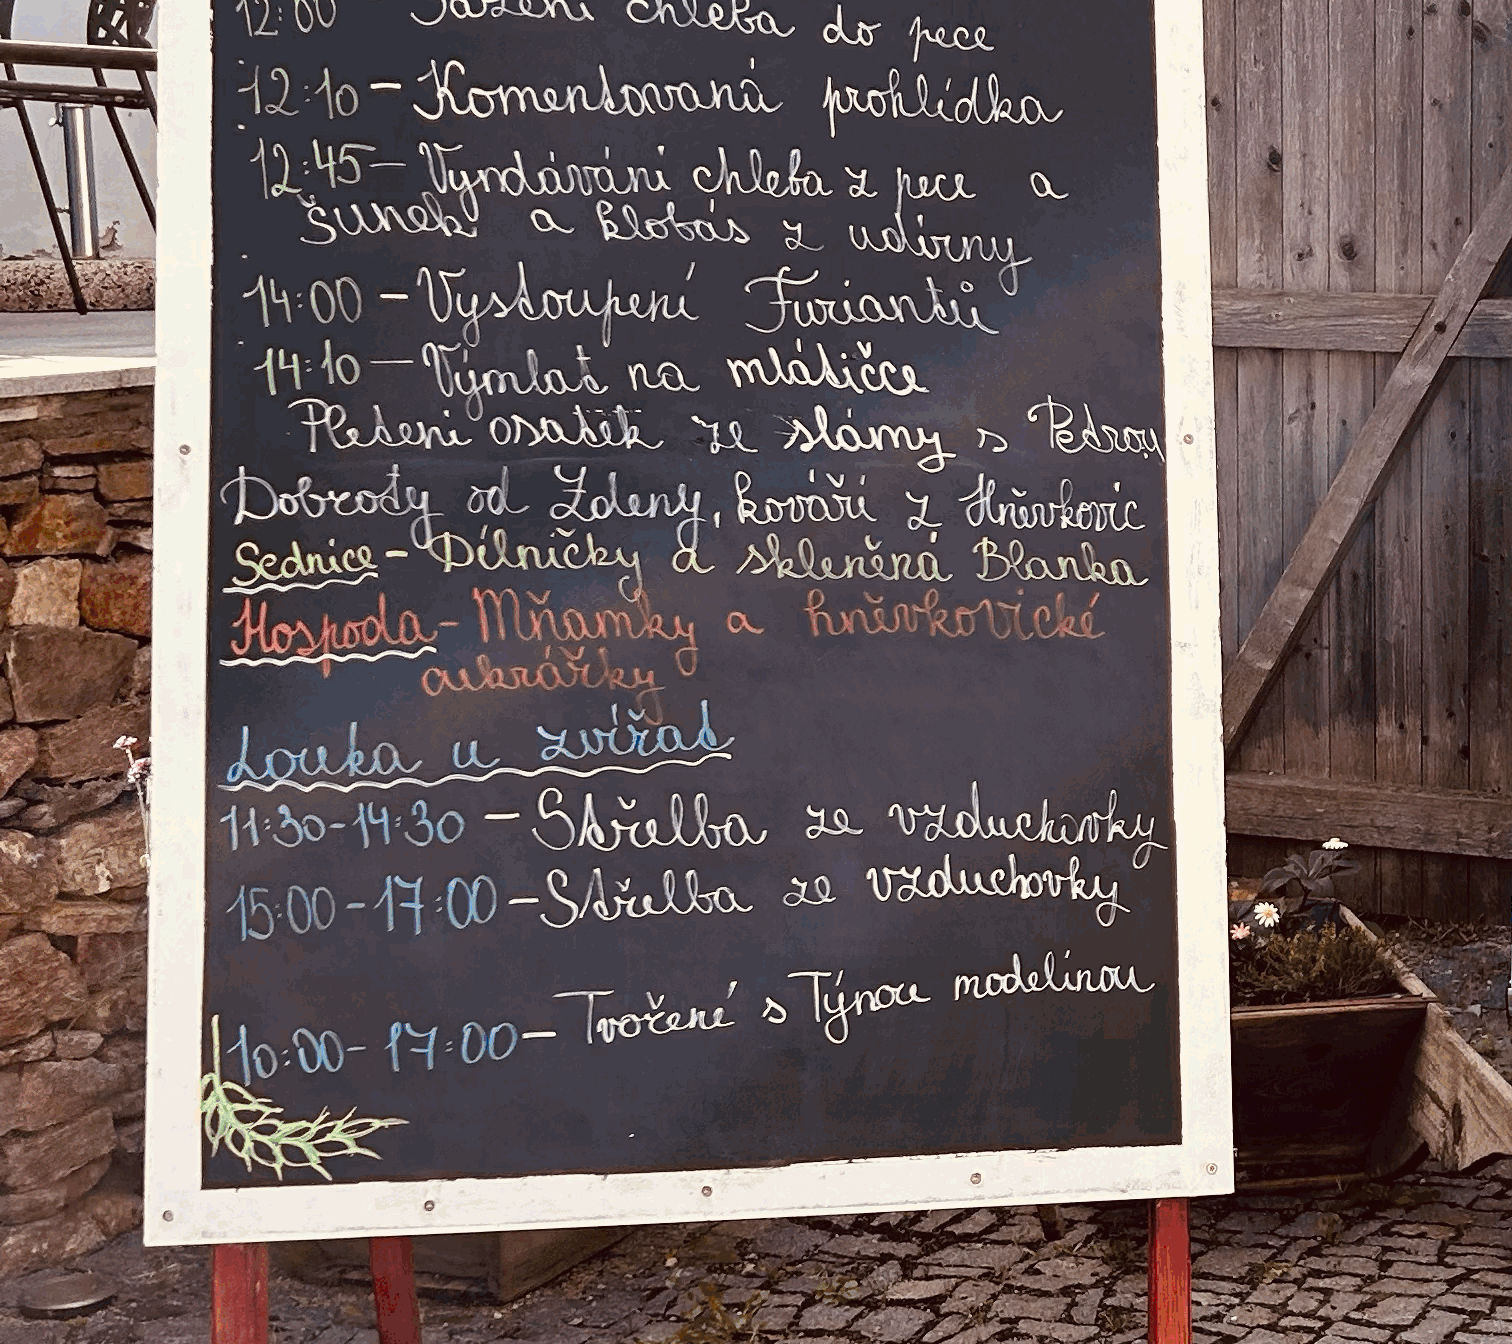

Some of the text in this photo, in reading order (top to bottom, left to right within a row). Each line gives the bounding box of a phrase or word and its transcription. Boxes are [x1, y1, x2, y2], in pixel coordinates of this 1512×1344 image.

[823, 4, 881, 46] do
[909, 16, 995, 62] pece
[238, 64, 358, 119] 12:10
[413, 57, 783, 120] Komentovaná
[822, 68, 1063, 137] prohlídka
[250, 137, 376, 199] 12:45
[692, 146, 833, 197] chleba
[845, 166, 877, 198] z
[896, 166, 976, 213] pece
[1029, 172, 1068, 200] a
[530, 208, 574, 234] a
[783, 219, 825, 250] z
[242, 274, 362, 327] 14:00
[417, 260, 699, 347] Vystoupení
[744, 265, 999, 334] Furiantů
[253, 338, 361, 395] 14:10
[422, 342, 608, 420] Výmlat
[628, 361, 701, 392] na
[726, 337, 930, 395] mlátičce
[691, 414, 759, 454] ze
[977, 427, 1009, 453] s
[467, 466, 529, 515] od
[905, 490, 942, 531] z
[231, 541, 379, 587] Sednice
[672, 546, 715, 574] a
[736, 531, 953, 582] skleněná
[972, 536, 1149, 585] Blanka
[231, 591, 438, 678] Hospoda
[472, 586, 698, 675] Mňamky
[726, 611, 765, 635] a
[226, 699, 735, 782] Louka u zvířat
[531, 787, 767, 851] Střelba
[805, 804, 863, 839] ze
[226, 884, 335, 941] 15:00
[374, 874, 497, 935] 17:00
[539, 867, 753, 929] Střelba
[783, 875, 836, 906] ze
[866, 853, 1130, 927] vzduchovky
[761, 996, 787, 1024] s
